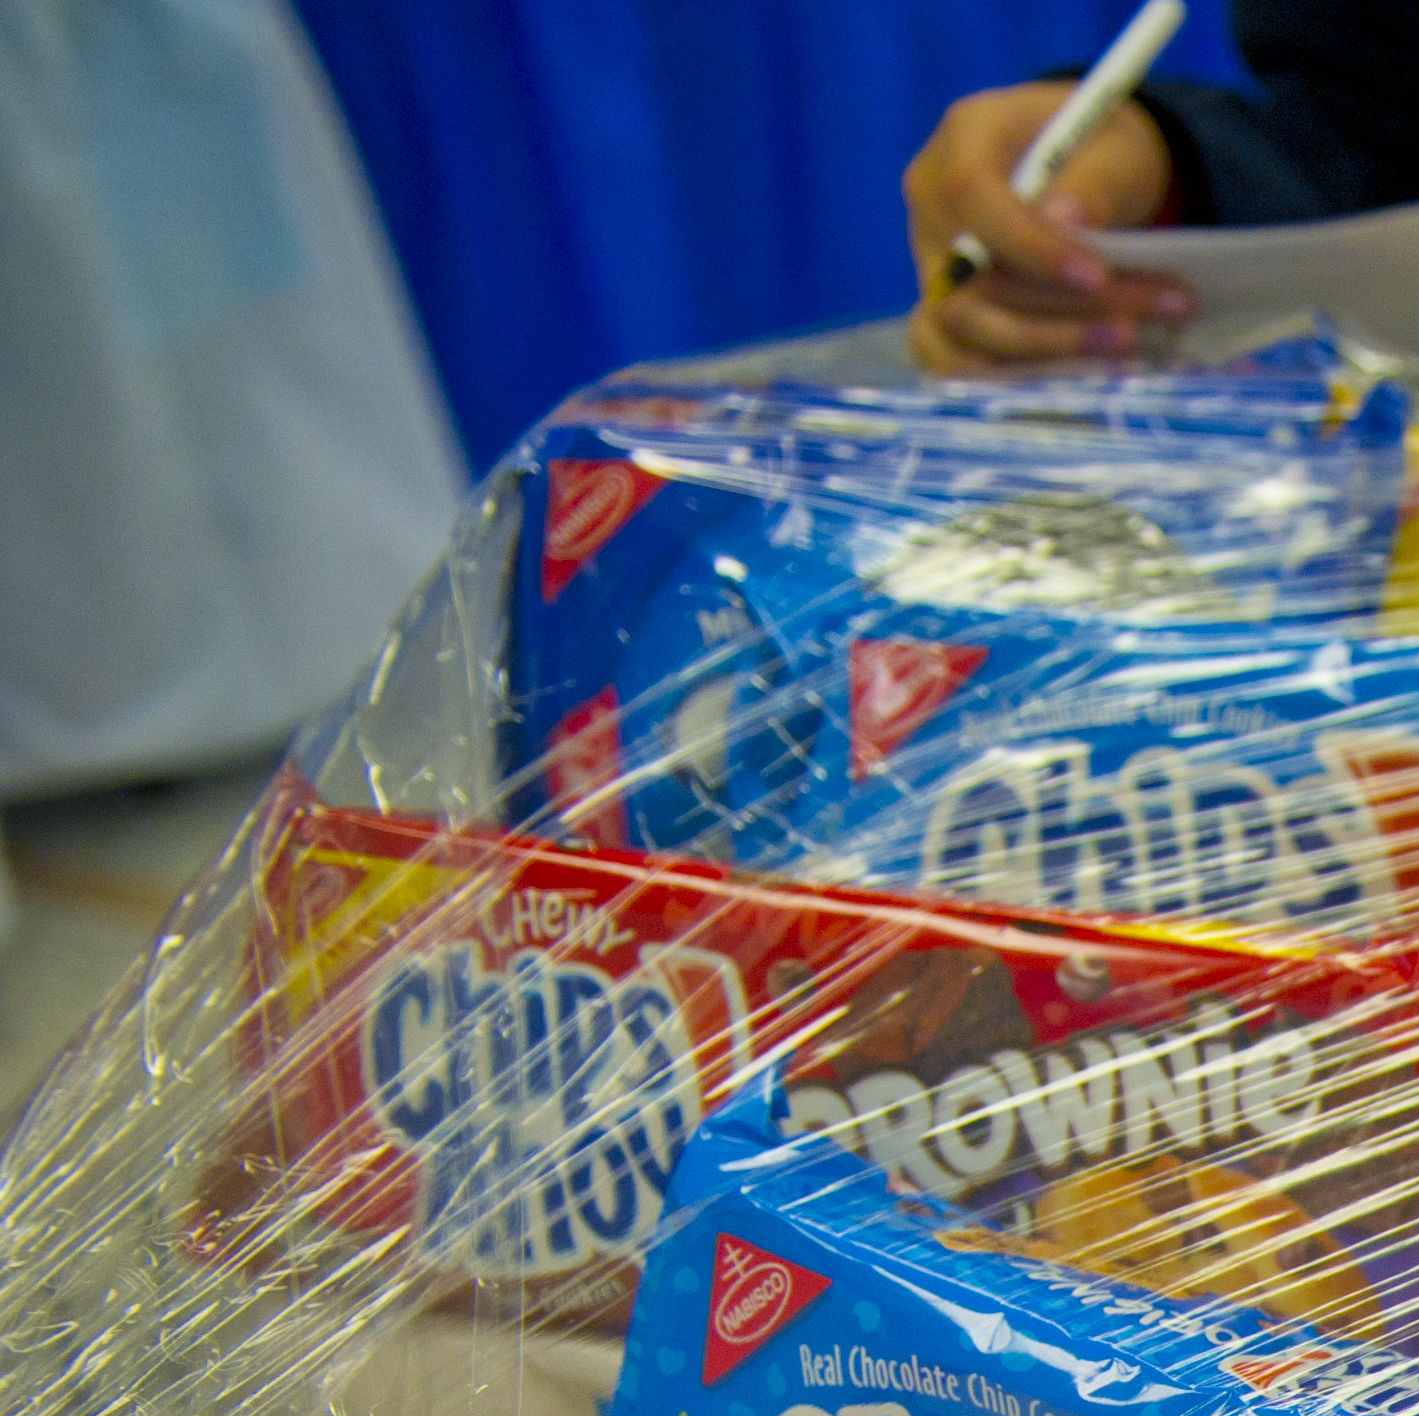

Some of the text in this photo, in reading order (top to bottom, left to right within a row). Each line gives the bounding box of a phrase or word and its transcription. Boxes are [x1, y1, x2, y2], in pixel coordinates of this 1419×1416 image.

[721, 1272, 786, 1335] NABISCO
[799, 1344, 844, 1389] Real
[848, 1345, 961, 1403] Chocolate
